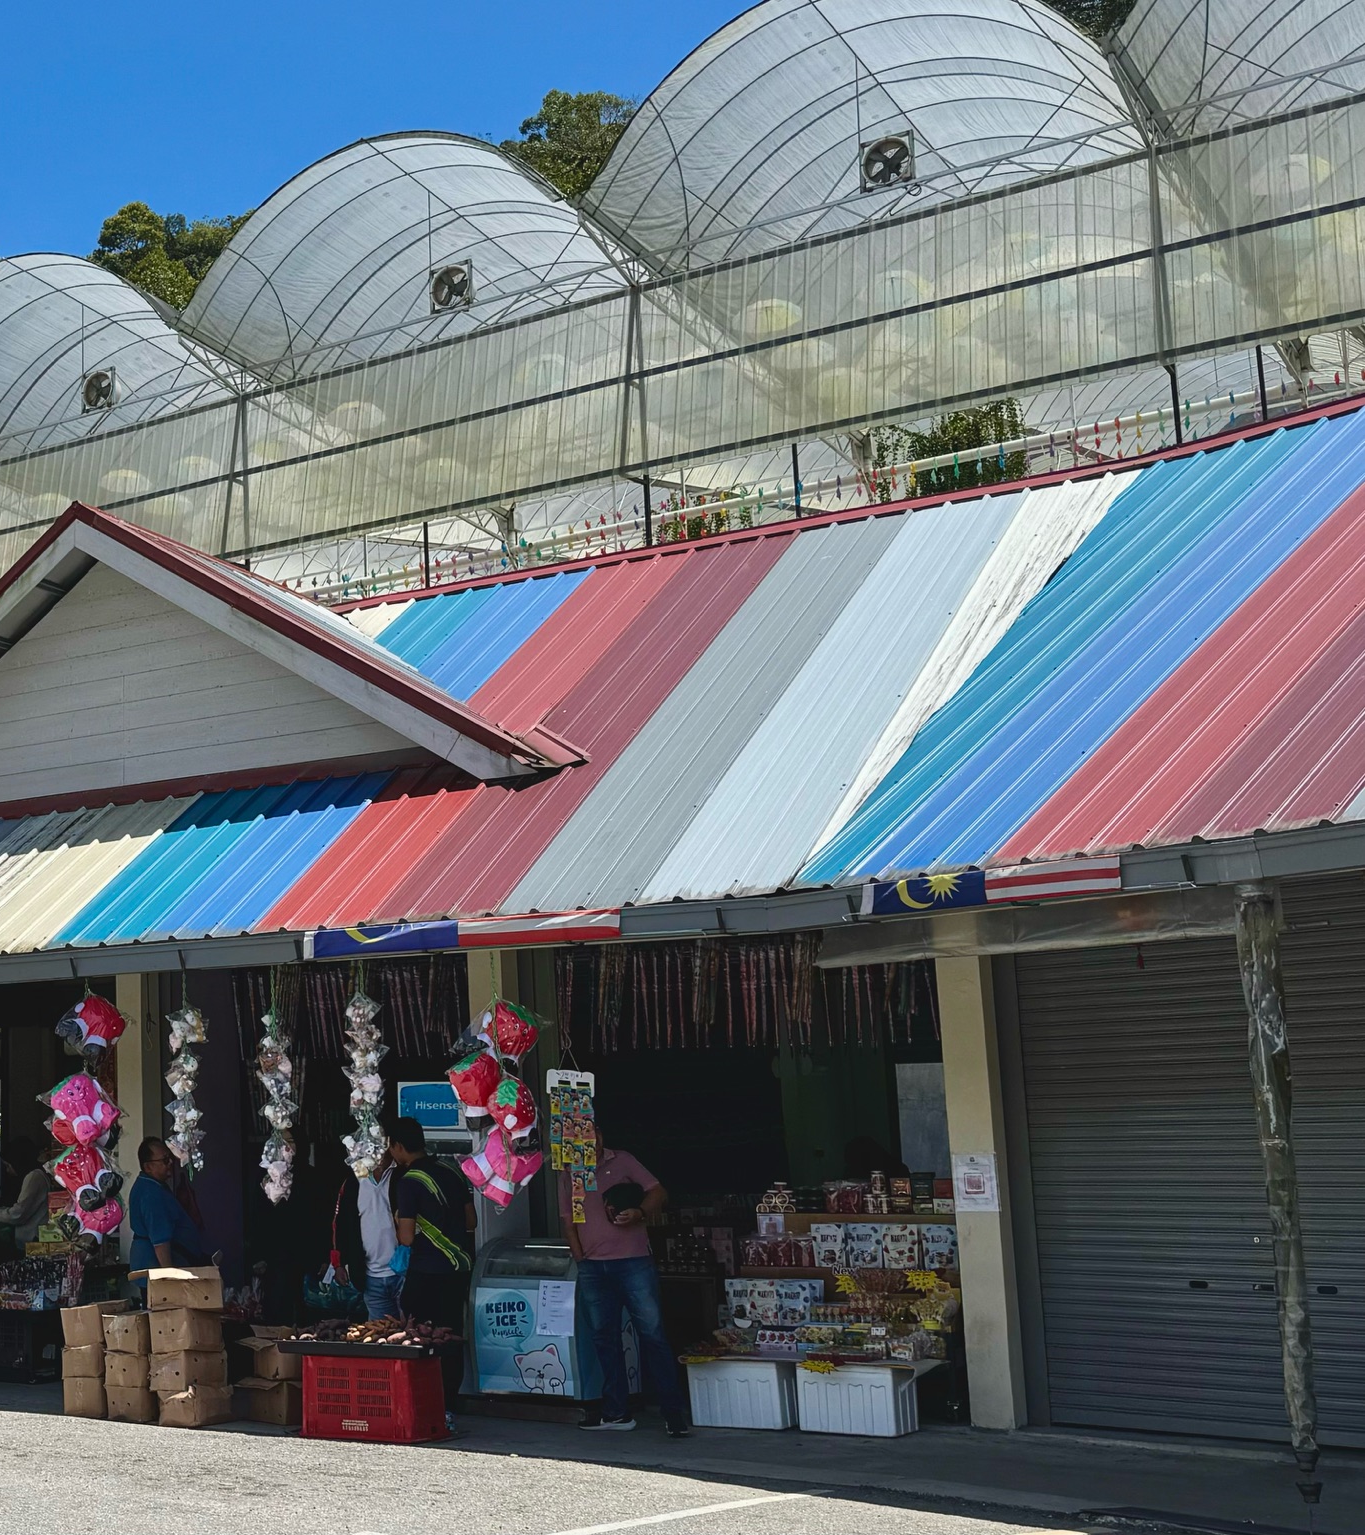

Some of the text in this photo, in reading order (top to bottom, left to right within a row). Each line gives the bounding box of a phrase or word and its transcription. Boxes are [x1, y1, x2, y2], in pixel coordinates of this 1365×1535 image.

[415, 1101, 462, 1110] Hisense
[485, 1301, 526, 1314] KEIKO
[496, 1315, 517, 1326] ICE
